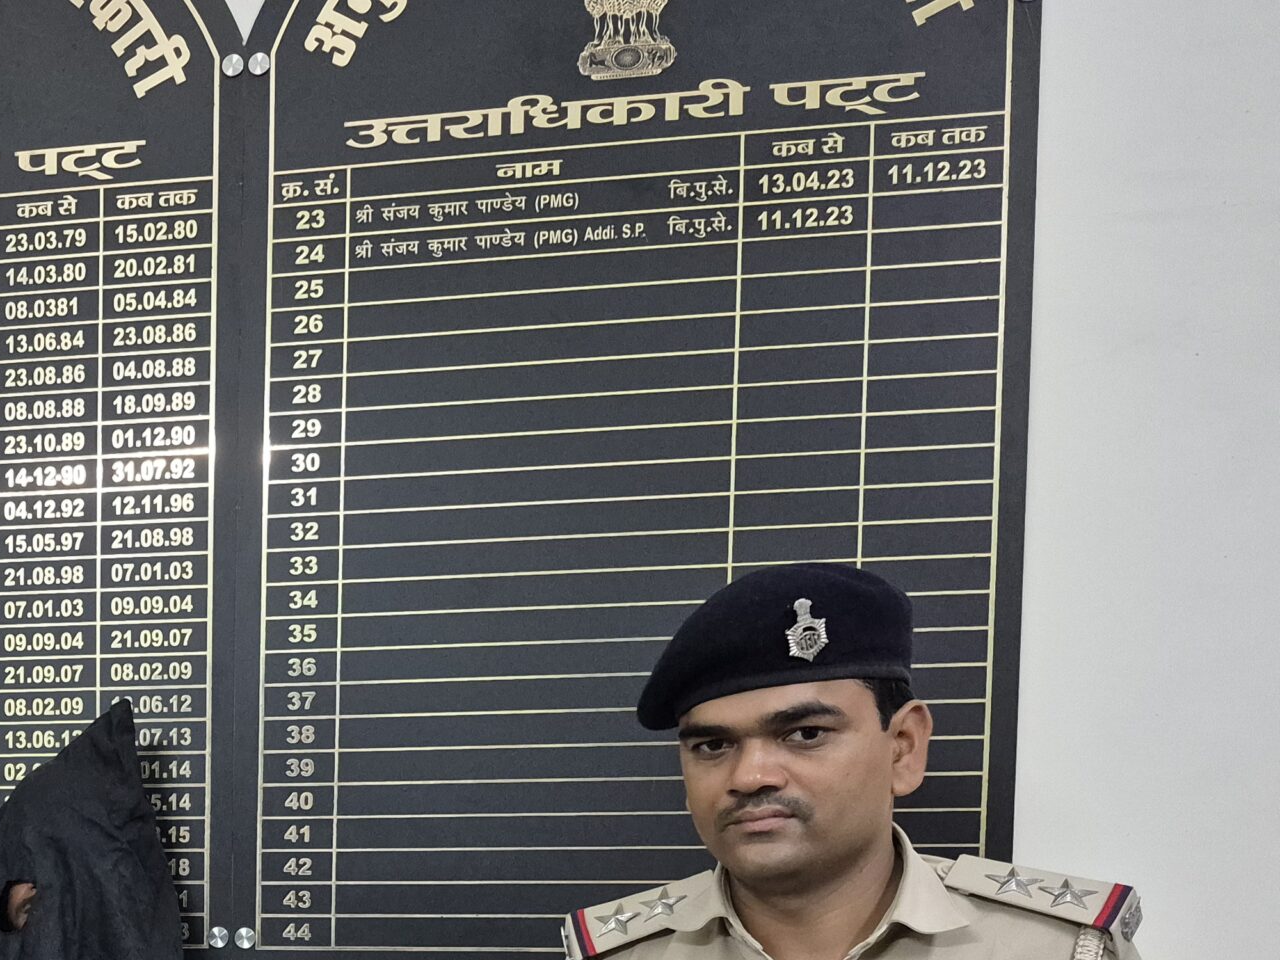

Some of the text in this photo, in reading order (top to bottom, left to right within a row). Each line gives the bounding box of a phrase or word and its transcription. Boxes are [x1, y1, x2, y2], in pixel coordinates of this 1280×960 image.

[344, 79, 750, 148] उत्तराधिकारी
[772, 132, 845, 157] कब से
[891, 126, 988, 148] कब तक
[496, 160, 563, 178] नाम
[888, 159, 986, 184] 11.12.23
[759, 169, 854, 194] 13.04.23
[17, 195, 77, 218] कब से
[116, 189, 198, 209] कब तक
[356, 192, 578, 223] श्री संजय कुमार पाण्डेय (PMG)
[296, 209, 325, 229] 23
[758, 205, 853, 230] 11.12.23
[6, 228, 86, 252] 23.03.79
[115, 220, 197, 243] 15.02.80
[295, 244, 324, 264] 24
[355, 240, 373, 258] श्री
[380, 238, 419, 256] संजय
[427, 237, 468, 257] कुमार
[474, 228, 525, 249] पाण्डेय
[534, 229, 578, 249] (PMG)
[6, 262, 86, 286] 14.03.80
[114, 254, 195, 278] 20.02.81
[114, 288, 197, 312] 05.04.84
[295, 279, 323, 299] 25
[5, 297, 77, 320] 08.0381
[6, 330, 84, 353] 13.06.84
[113, 323, 196, 346] 23.08.86
[113, 357, 195, 380] 04.08.88
[293, 349, 322, 369] 27
[5, 364, 85, 387] 23.08.86
[5, 398, 85, 421] 08.08.88
[113, 392, 195, 414] 18.09.89
[112, 425, 195, 448] 01.12.90
[292, 419, 321, 438] 29
[4, 432, 85, 454] 23.10.89
[112, 458, 195, 482] 31.07.92
[112, 493, 194, 515] 12.11.96
[291, 487, 317, 506] 31
[4, 498, 84, 520] 04.12.92
[5, 532, 84, 553] 15.05.97
[111, 527, 193, 549] 21.08.98
[4, 565, 84, 586] 21.08.98
[111, 561, 193, 582] 07.01.03
[289, 556, 318, 575] 33
[4, 599, 83, 619] 07.01.03
[111, 595, 193, 615] 09.09.04
[4, 632, 84, 651] 09.09.04
[111, 629, 192, 648] 21.09.07
[288, 624, 317, 642] 35
[4, 665, 83, 684] 21.09.07
[111, 662, 192, 681] 08.02.09
[4, 697, 83, 716] 08.02.09
[287, 691, 316, 710] 37
[286, 758, 314, 777] 39
[284, 825, 310, 842] 41
[283, 923, 311, 941] 44
